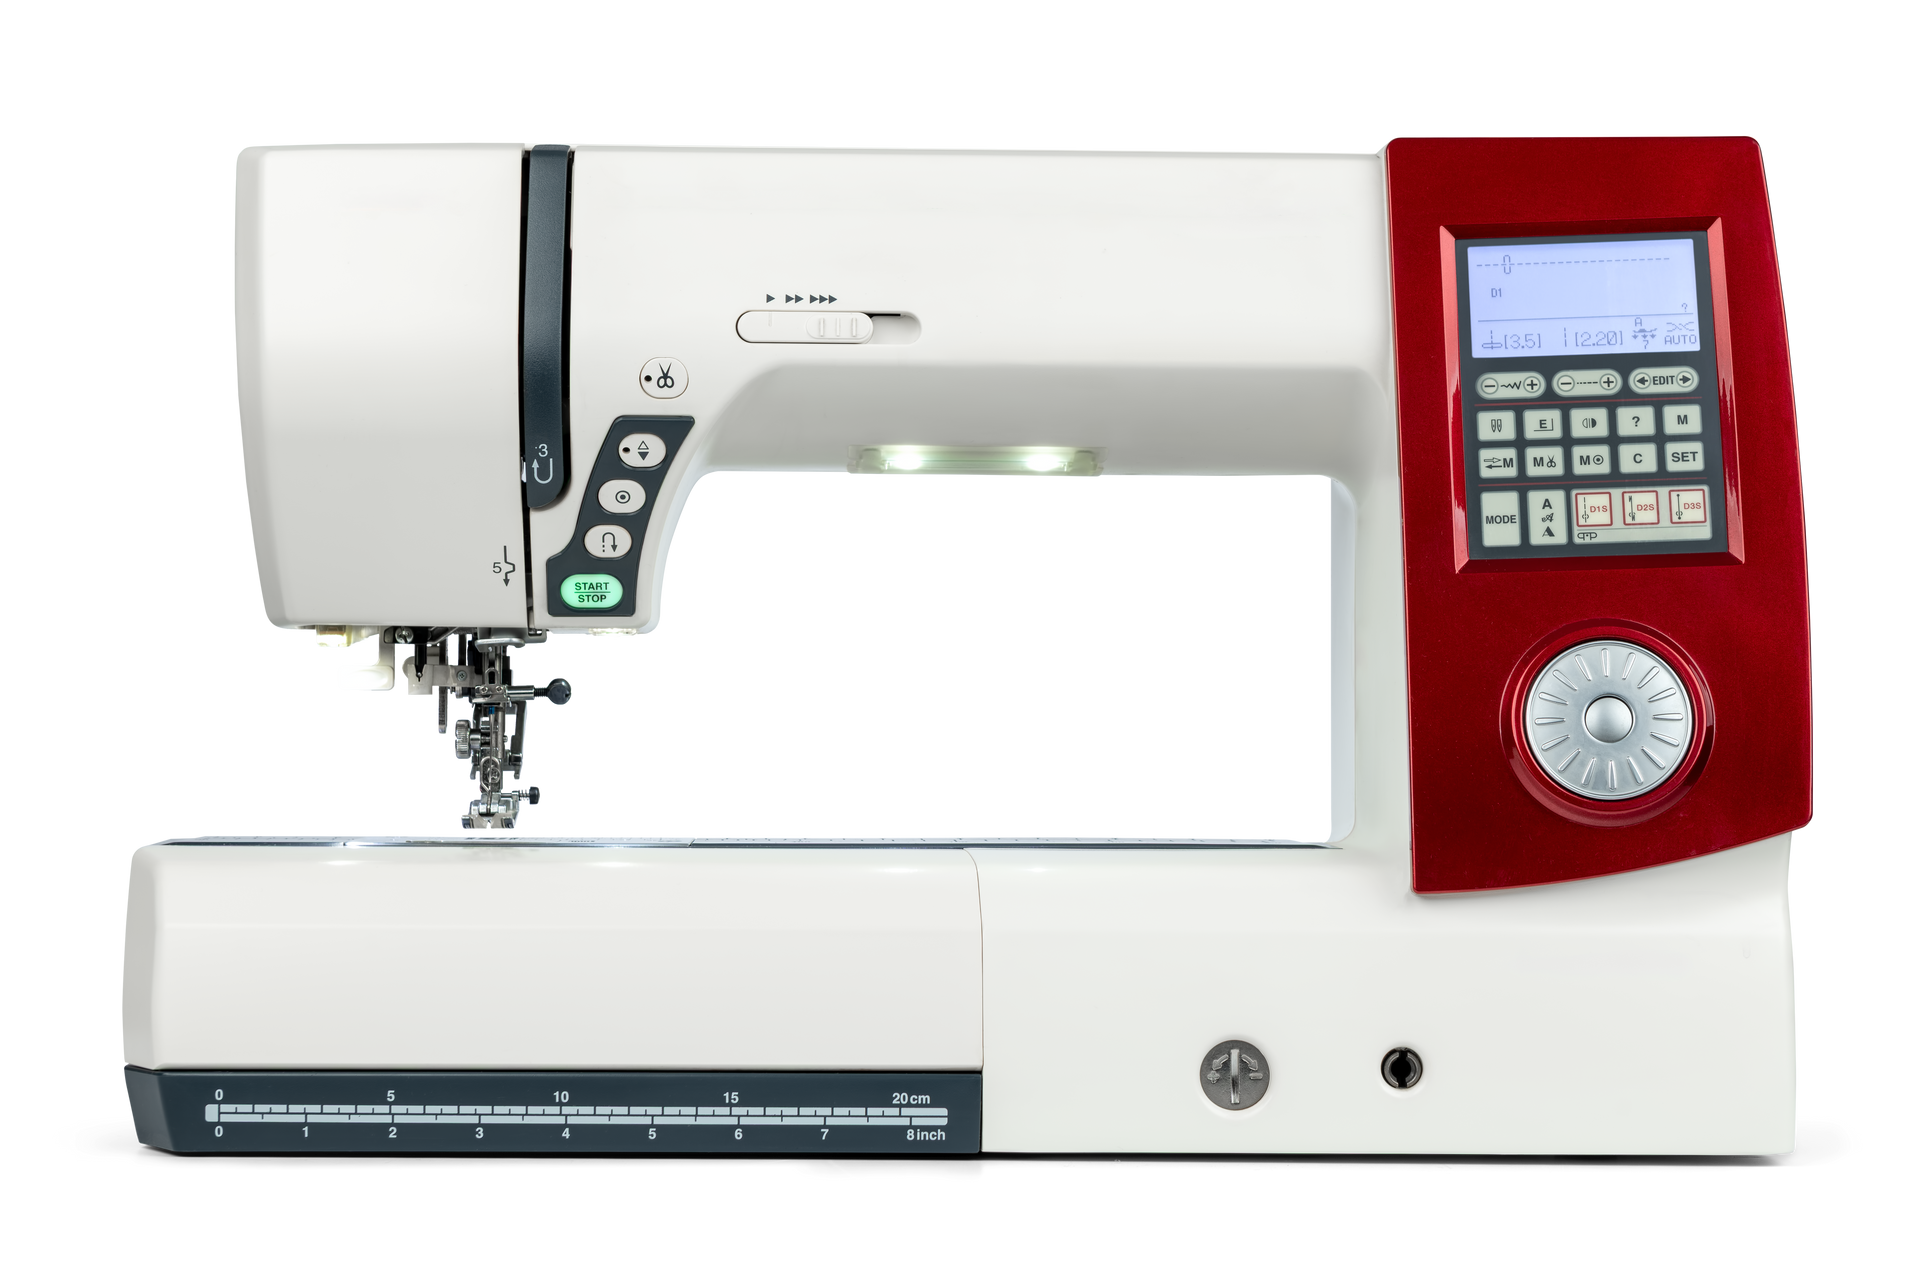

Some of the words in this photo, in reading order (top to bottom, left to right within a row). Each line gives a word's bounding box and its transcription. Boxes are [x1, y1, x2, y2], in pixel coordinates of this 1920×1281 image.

[1491, 288, 1502, 298] D1
[1664, 335, 1697, 345] AUTO
[1652, 375, 1675, 385] EDIT
[1539, 419, 1547, 429] E
[1677, 415, 1688, 425] M
[538, 444, 548, 457] 3
[1579, 455, 1591, 466] M
[1633, 453, 1643, 464] C
[1671, 451, 1698, 462] SET
[1502, 458, 1514, 468] M
[1533, 457, 1544, 467] M
[1542, 499, 1552, 509] A
[1590, 505, 1608, 513] D1S
[1636, 504, 1655, 512] D2S
[1683, 502, 1701, 510] D3S
[1485, 514, 1517, 524] MODE
[492, 562, 502, 574] 5
[574, 582, 610, 591] START
[578, 594, 607, 603] STOP
[215, 1089, 224, 1101] 0
[386, 1090, 395, 1102] 5
[553, 1091, 569, 1103] 10
[723, 1092, 739, 1104] 15
[215, 1125, 224, 1138] 0
[302, 1126, 309, 1138] 1
[388, 1126, 397, 1138] 2
[475, 1127, 484, 1139] 3
[561, 1128, 571, 1140] 4
[648, 1128, 656, 1140] 5
[734, 1128, 743, 1141] 6
[820, 1129, 829, 1141] 7
